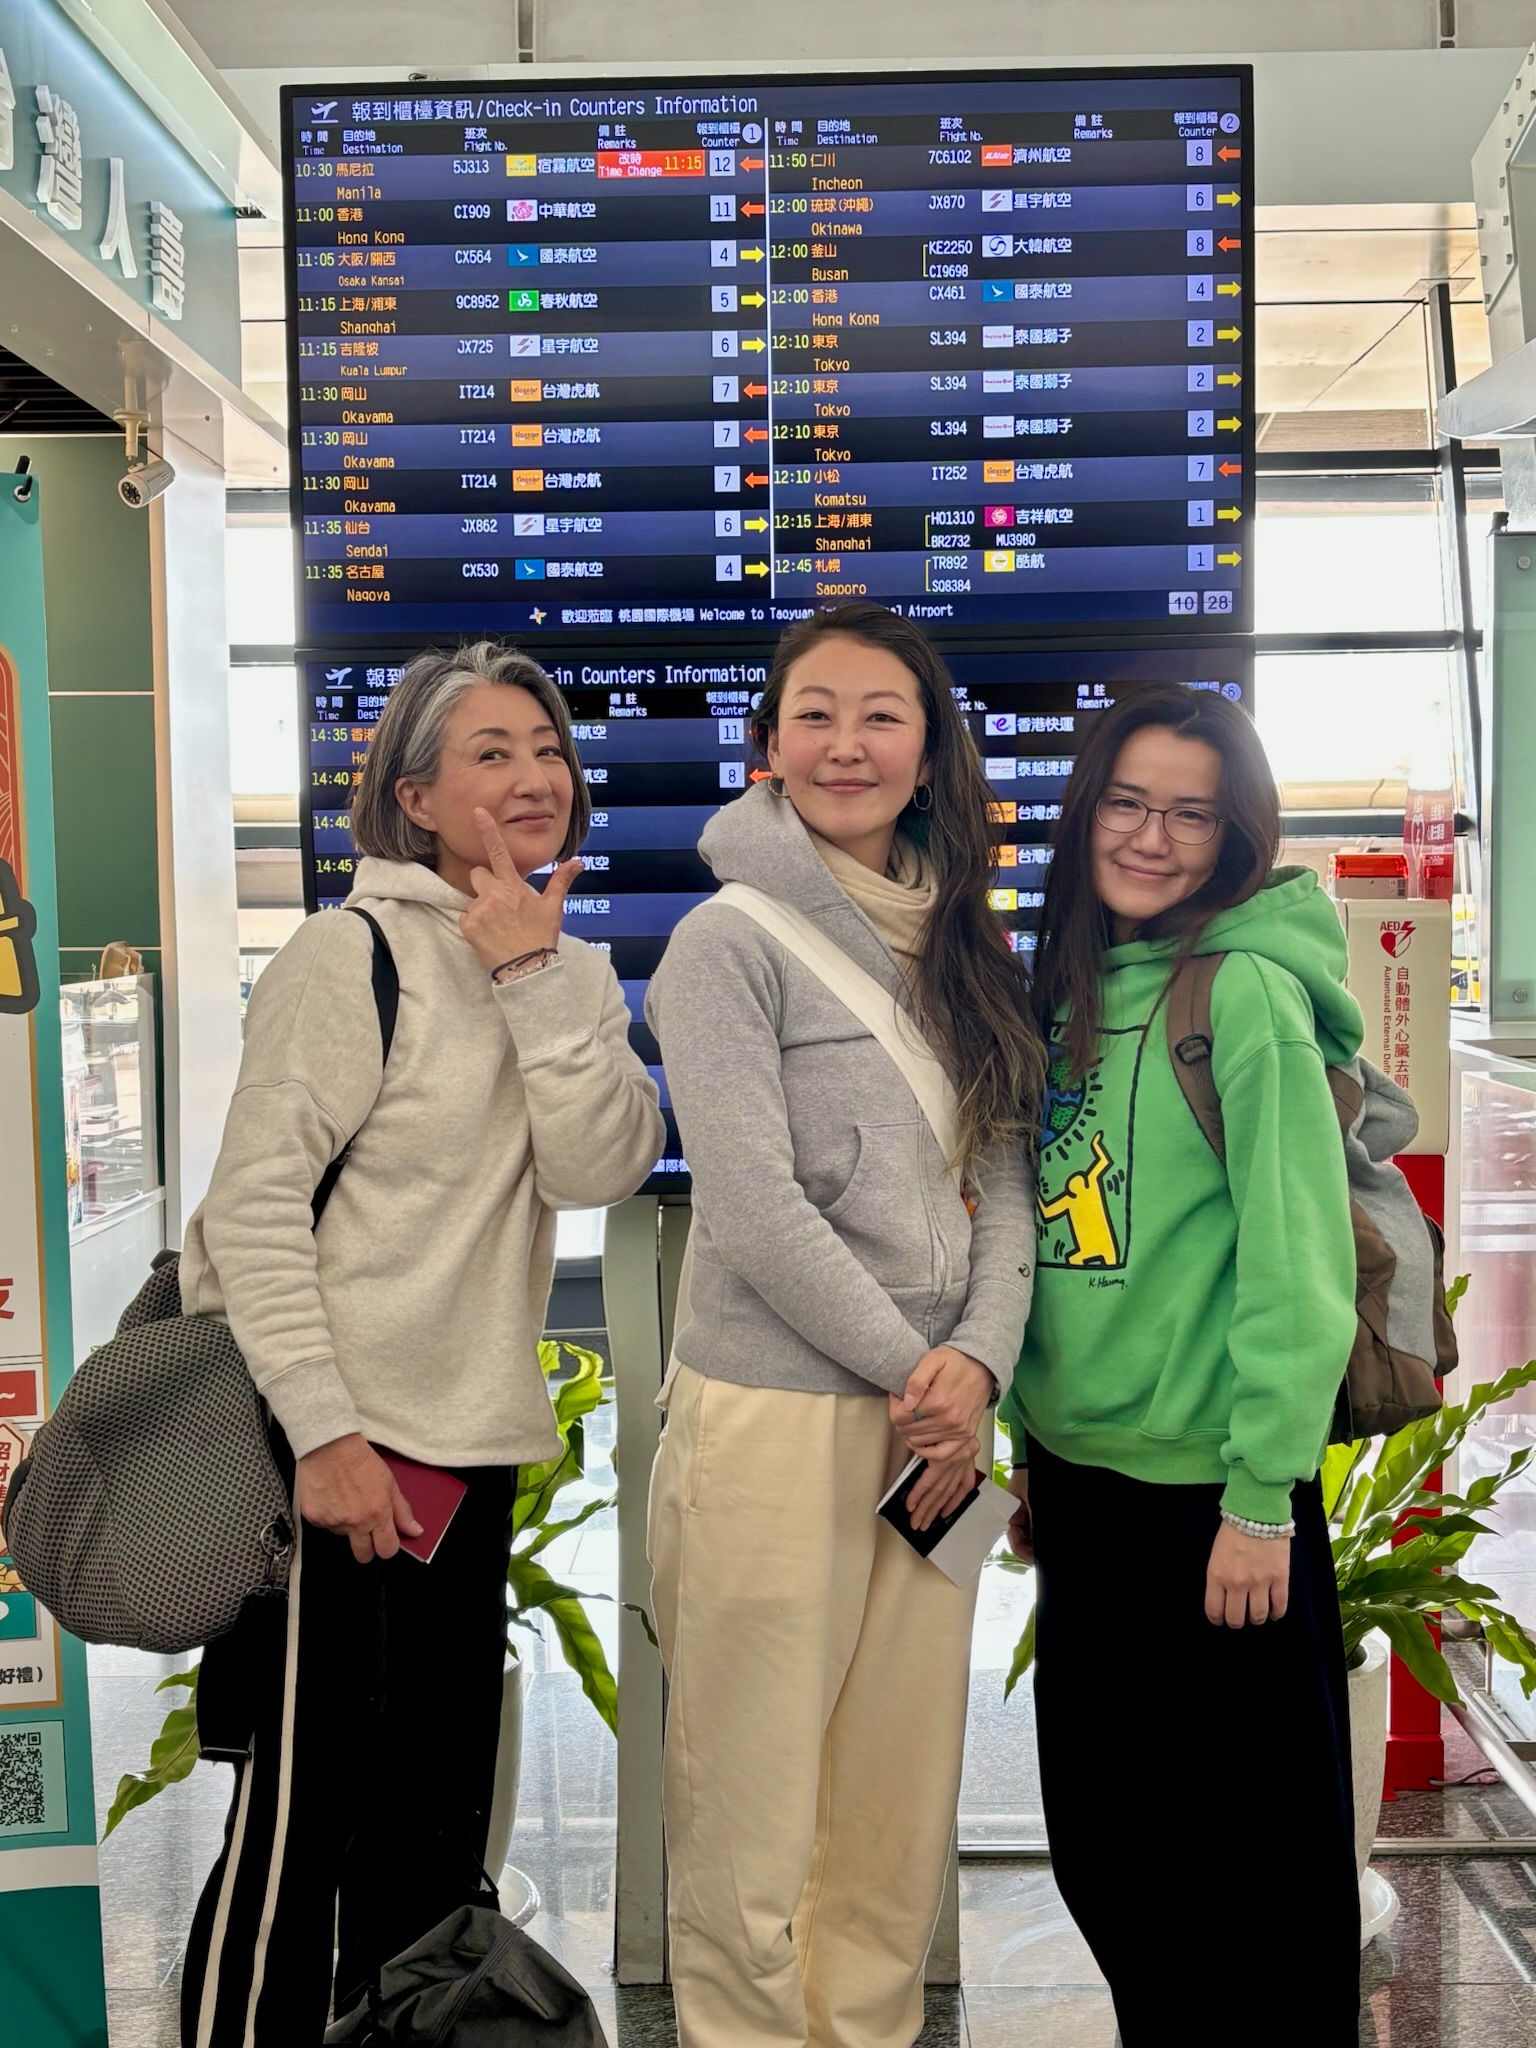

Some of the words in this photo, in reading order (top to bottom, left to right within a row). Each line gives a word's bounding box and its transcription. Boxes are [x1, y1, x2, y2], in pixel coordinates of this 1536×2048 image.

[570, 98, 644, 116] Counters
[655, 96, 757, 114] Information
[818, 120, 850, 132] 目的地
[343, 131, 375, 142] 目的地
[817, 134, 877, 145] Destination
[940, 131, 967, 142] Flight
[1074, 129, 1112, 139] Remarks
[1179, 127, 1217, 137] Counter
[343, 144, 403, 154] Destination
[464, 142, 492, 152] Flight
[598, 139, 636, 149] Remarks
[702, 137, 740, 147] Counter
[296, 164, 332, 177] 10:30
[336, 163, 374, 176] 馬尼拉
[453, 160, 489, 173] 5J313
[665, 156, 701, 170] 11:15
[715, 157, 730, 171] 12
[770, 154, 806, 167] 11:50
[810, 153, 835, 167] 仁川
[929, 150, 971, 164] 7C6102
[337, 187, 381, 199] Manila
[600, 167, 621, 176] Time
[628, 166, 662, 177] Change
[812, 178, 862, 190] Incheon
[771, 200, 807, 213] 12:00
[929, 195, 965, 209] JX870
[1014, 193, 1071, 208] 星宇航空
[297, 209, 333, 222] 11:00
[337, 208, 363, 221] 香港
[454, 205, 490, 219] CI909
[539, 203, 596, 218] 中華航空
[715, 203, 731, 217] 11
[338, 233, 368, 244] Hong
[375, 232, 404, 244] Kong
[812, 223, 862, 236] Okinawa
[298, 253, 334, 266] 11:05
[455, 250, 491, 263] CX564
[540, 248, 597, 263] 國泰航空
[771, 245, 807, 258] 12:00
[811, 244, 837, 258] 釜山
[929, 241, 972, 254] KE2250
[1014, 239, 1072, 253] 大韓航空
[339, 276, 366, 286] Osaka
[371, 276, 404, 286] Kansai
[812, 268, 848, 281] Busan
[929, 265, 968, 278] CI9698
[299, 298, 335, 311] 11:15
[456, 295, 499, 308] 9C8952
[541, 293, 598, 308] 春秋航空
[772, 290, 808, 303] 12:00
[812, 290, 837, 303] 香港
[930, 286, 966, 300] CX461
[1015, 284, 1072, 299] 國泰航空
[341, 321, 396, 334] Shanghai
[813, 314, 842, 326] Hong
[850, 313, 879, 325] Kong
[772, 335, 809, 348] 12:10
[812, 334, 838, 348] 東京
[930, 331, 966, 345] SL394
[1015, 329, 1072, 344] 泰國獅子
[300, 343, 336, 356] 11:15
[340, 343, 379, 356] 吉隆坡
[457, 340, 493, 353] JX725
[542, 339, 598, 353] 星宇航空
[341, 366, 369, 376] Kuala
[814, 359, 849, 371] Tokyo
[301, 388, 337, 401] 11:30
[341, 387, 366, 400] 岡山
[459, 386, 495, 398] IT214
[542, 384, 600, 398] 台灣虎航
[773, 380, 809, 394] 12:10
[813, 380, 838, 393] 東京
[930, 377, 967, 390] SL394
[1015, 374, 1072, 389] 泰國獅子
[343, 411, 393, 423] Okayama
[814, 404, 850, 417] Tokyo
[302, 432, 339, 445] 11:30
[342, 432, 368, 445] 岡山
[460, 430, 495, 443] IT214
[543, 429, 601, 444] 台灣虎航
[773, 425, 810, 439] 12:10
[813, 425, 839, 438] 東京
[930, 422, 967, 435] SL394
[1015, 419, 1073, 434] 泰國獅子
[344, 455, 394, 468] Okayama
[815, 449, 851, 462] Tokyo
[303, 477, 340, 490] 11:30
[344, 477, 369, 490] 岡山
[461, 475, 497, 488] IT214
[544, 473, 602, 488] 台灣虎航
[774, 470, 810, 484] 12:10
[814, 470, 840, 483] 小松
[932, 467, 967, 480] IT252
[1016, 464, 1073, 478] 台灣虎航
[345, 500, 395, 513] Okayama
[815, 493, 866, 506] Komatsu
[304, 521, 341, 535] 11:35
[345, 521, 370, 534] 仙台
[462, 519, 497, 533] JX862
[545, 518, 602, 532] 星宇航空
[775, 515, 811, 528] 12:15
[1016, 509, 1073, 524] 吉祥航空
[347, 545, 387, 557] Sendai
[816, 537, 871, 551] Shanghai
[932, 535, 970, 548] BR2732
[996, 534, 1036, 547] MU3980
[306, 566, 342, 579] 11:35
[346, 566, 384, 579] 名古屋
[462, 564, 498, 577] CX530
[547, 562, 603, 577] 國泰航空
[775, 560, 811, 573] 12:45
[815, 559, 840, 572] 札幌
[932, 556, 967, 569] TR892
[1016, 554, 1044, 569] 酷航
[347, 589, 390, 602] Nagoya
[1175, 597, 1193, 610] 10
[1208, 596, 1228, 609] 28
[700, 609, 744, 621] Welcome
[908, 605, 953, 618] Airport
[582, 666, 655, 684] Counters
[665, 665, 766, 683] Information
[609, 707, 647, 717] Remarks
[711, 705, 748, 716] Counter
[311, 729, 347, 742] 14:35
[723, 725, 739, 740] 11
[312, 772, 349, 785] 14:40
[314, 816, 350, 829] 14:40
[316, 859, 353, 873] 14:45
[1380, 921, 1401, 931] AED
[1384, 966, 1392, 1012] Automated
[1384, 1016, 1392, 1051] External
